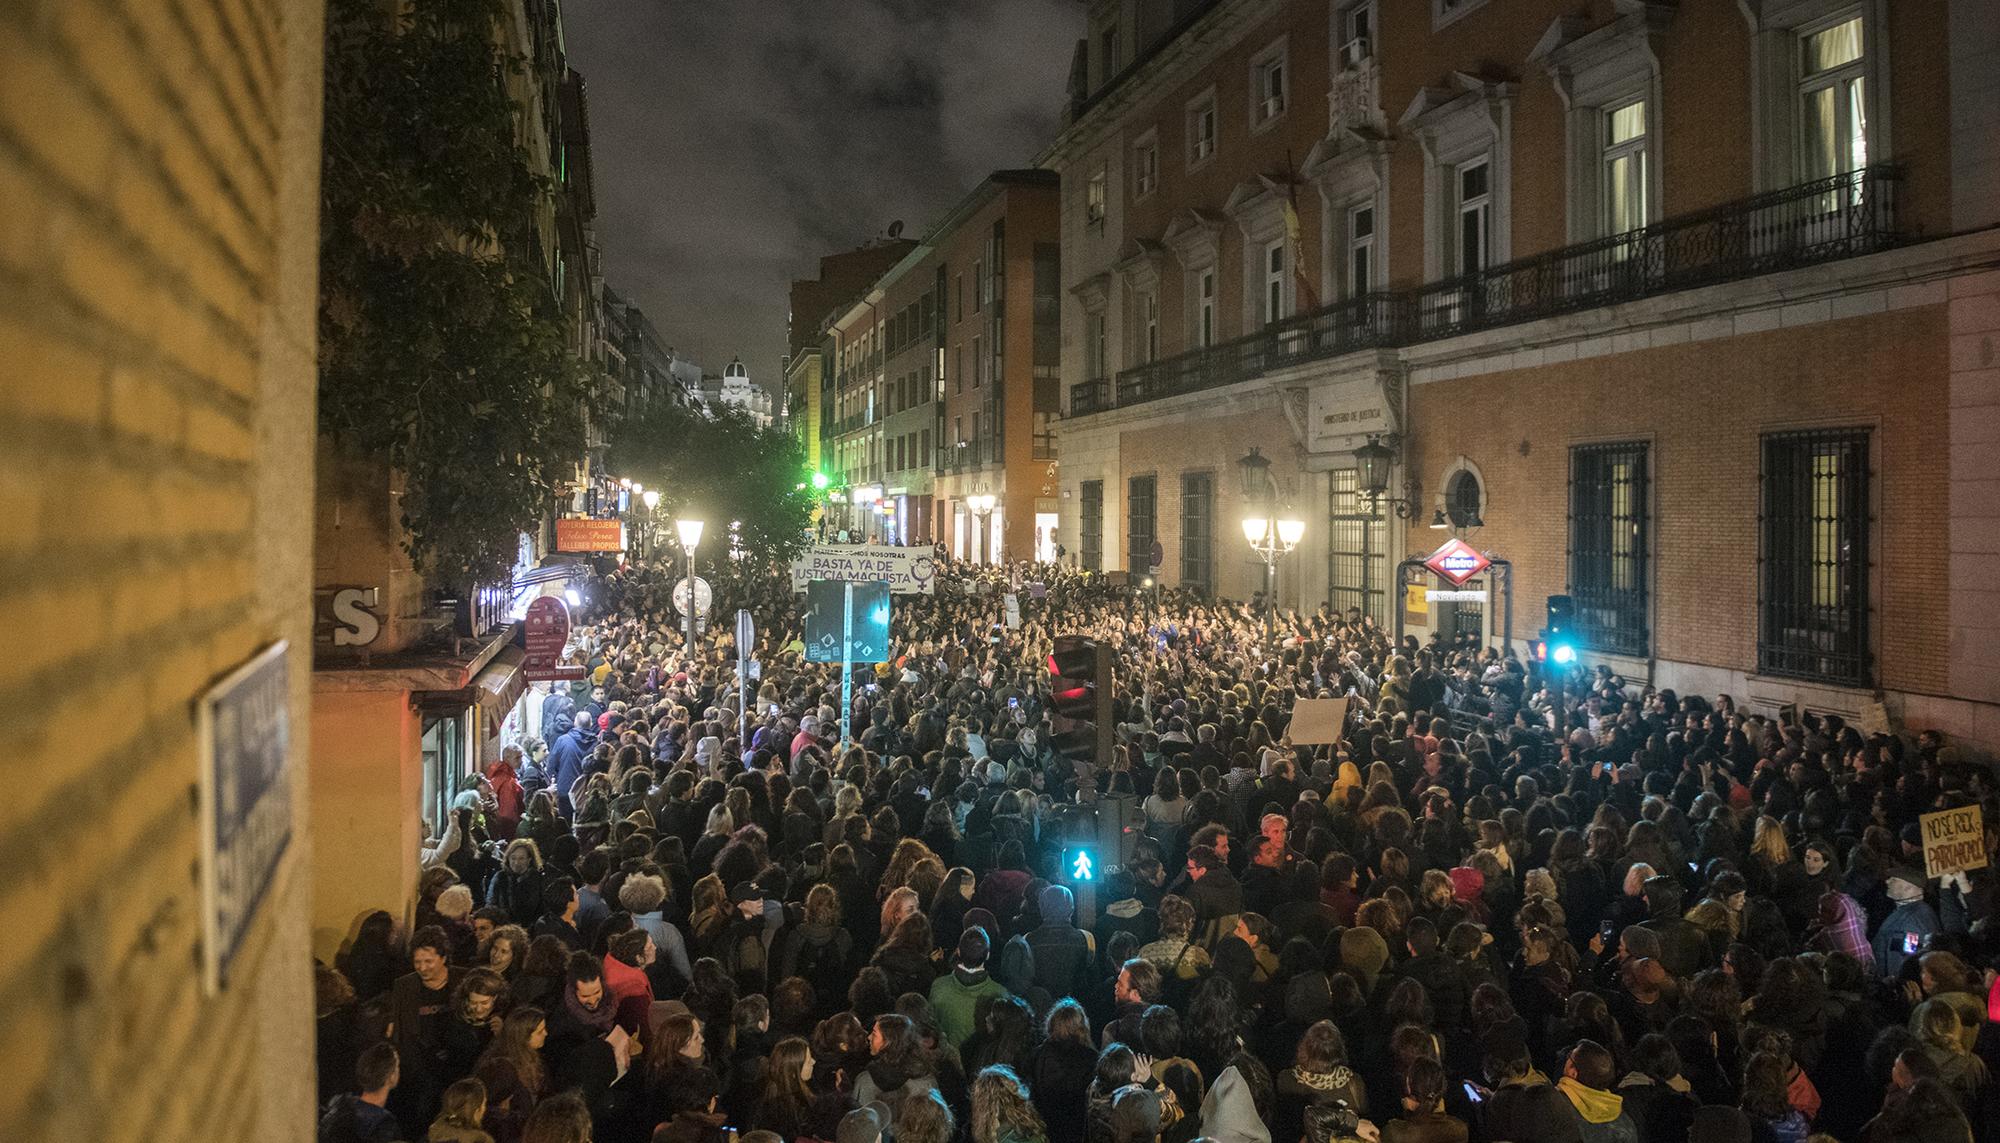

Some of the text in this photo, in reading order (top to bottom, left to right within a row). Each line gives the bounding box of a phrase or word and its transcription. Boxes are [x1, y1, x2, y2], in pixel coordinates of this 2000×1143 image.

[587, 521, 620, 529] RELOJERIA
[592, 541, 620, 549] PROPIOS
[870, 551, 906, 559] NOSOTRAS
[813, 558, 893, 571] BASTA YA DE
[1444, 557, 1474, 569] Metro
[795, 569, 844, 581] JUSTICIA
[332, 587, 379, 646] S
